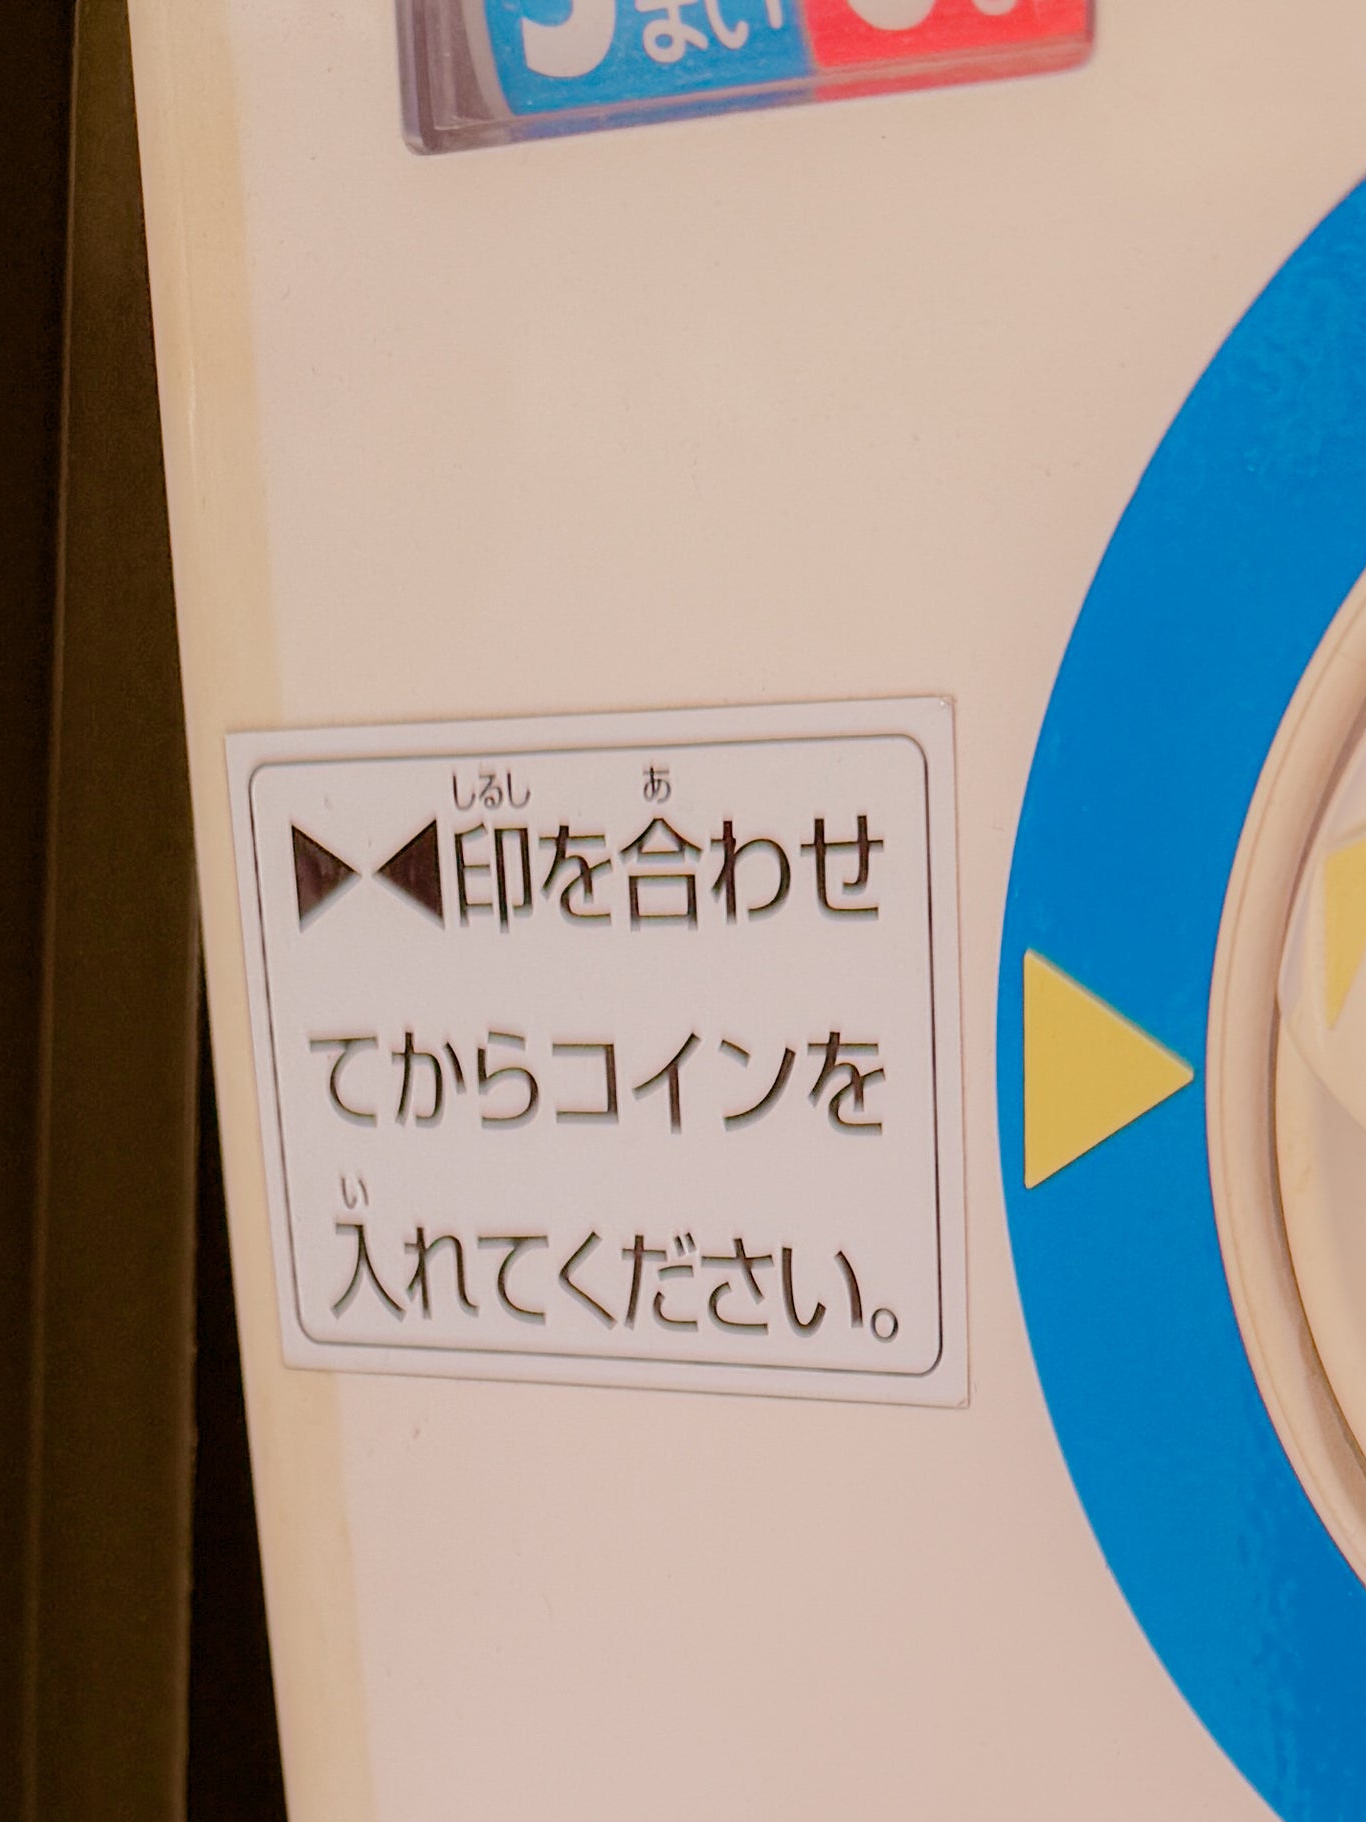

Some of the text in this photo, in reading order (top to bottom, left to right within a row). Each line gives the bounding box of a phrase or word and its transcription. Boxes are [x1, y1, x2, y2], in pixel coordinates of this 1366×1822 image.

[452, 770, 531, 812] しるし
[642, 764, 673, 803] あ
[452, 815, 885, 934] 印を合わせ
[308, 1030, 886, 1135] てからコインを
[339, 1175, 371, 1210] い
[331, 1222, 901, 1342] 入れてください。
